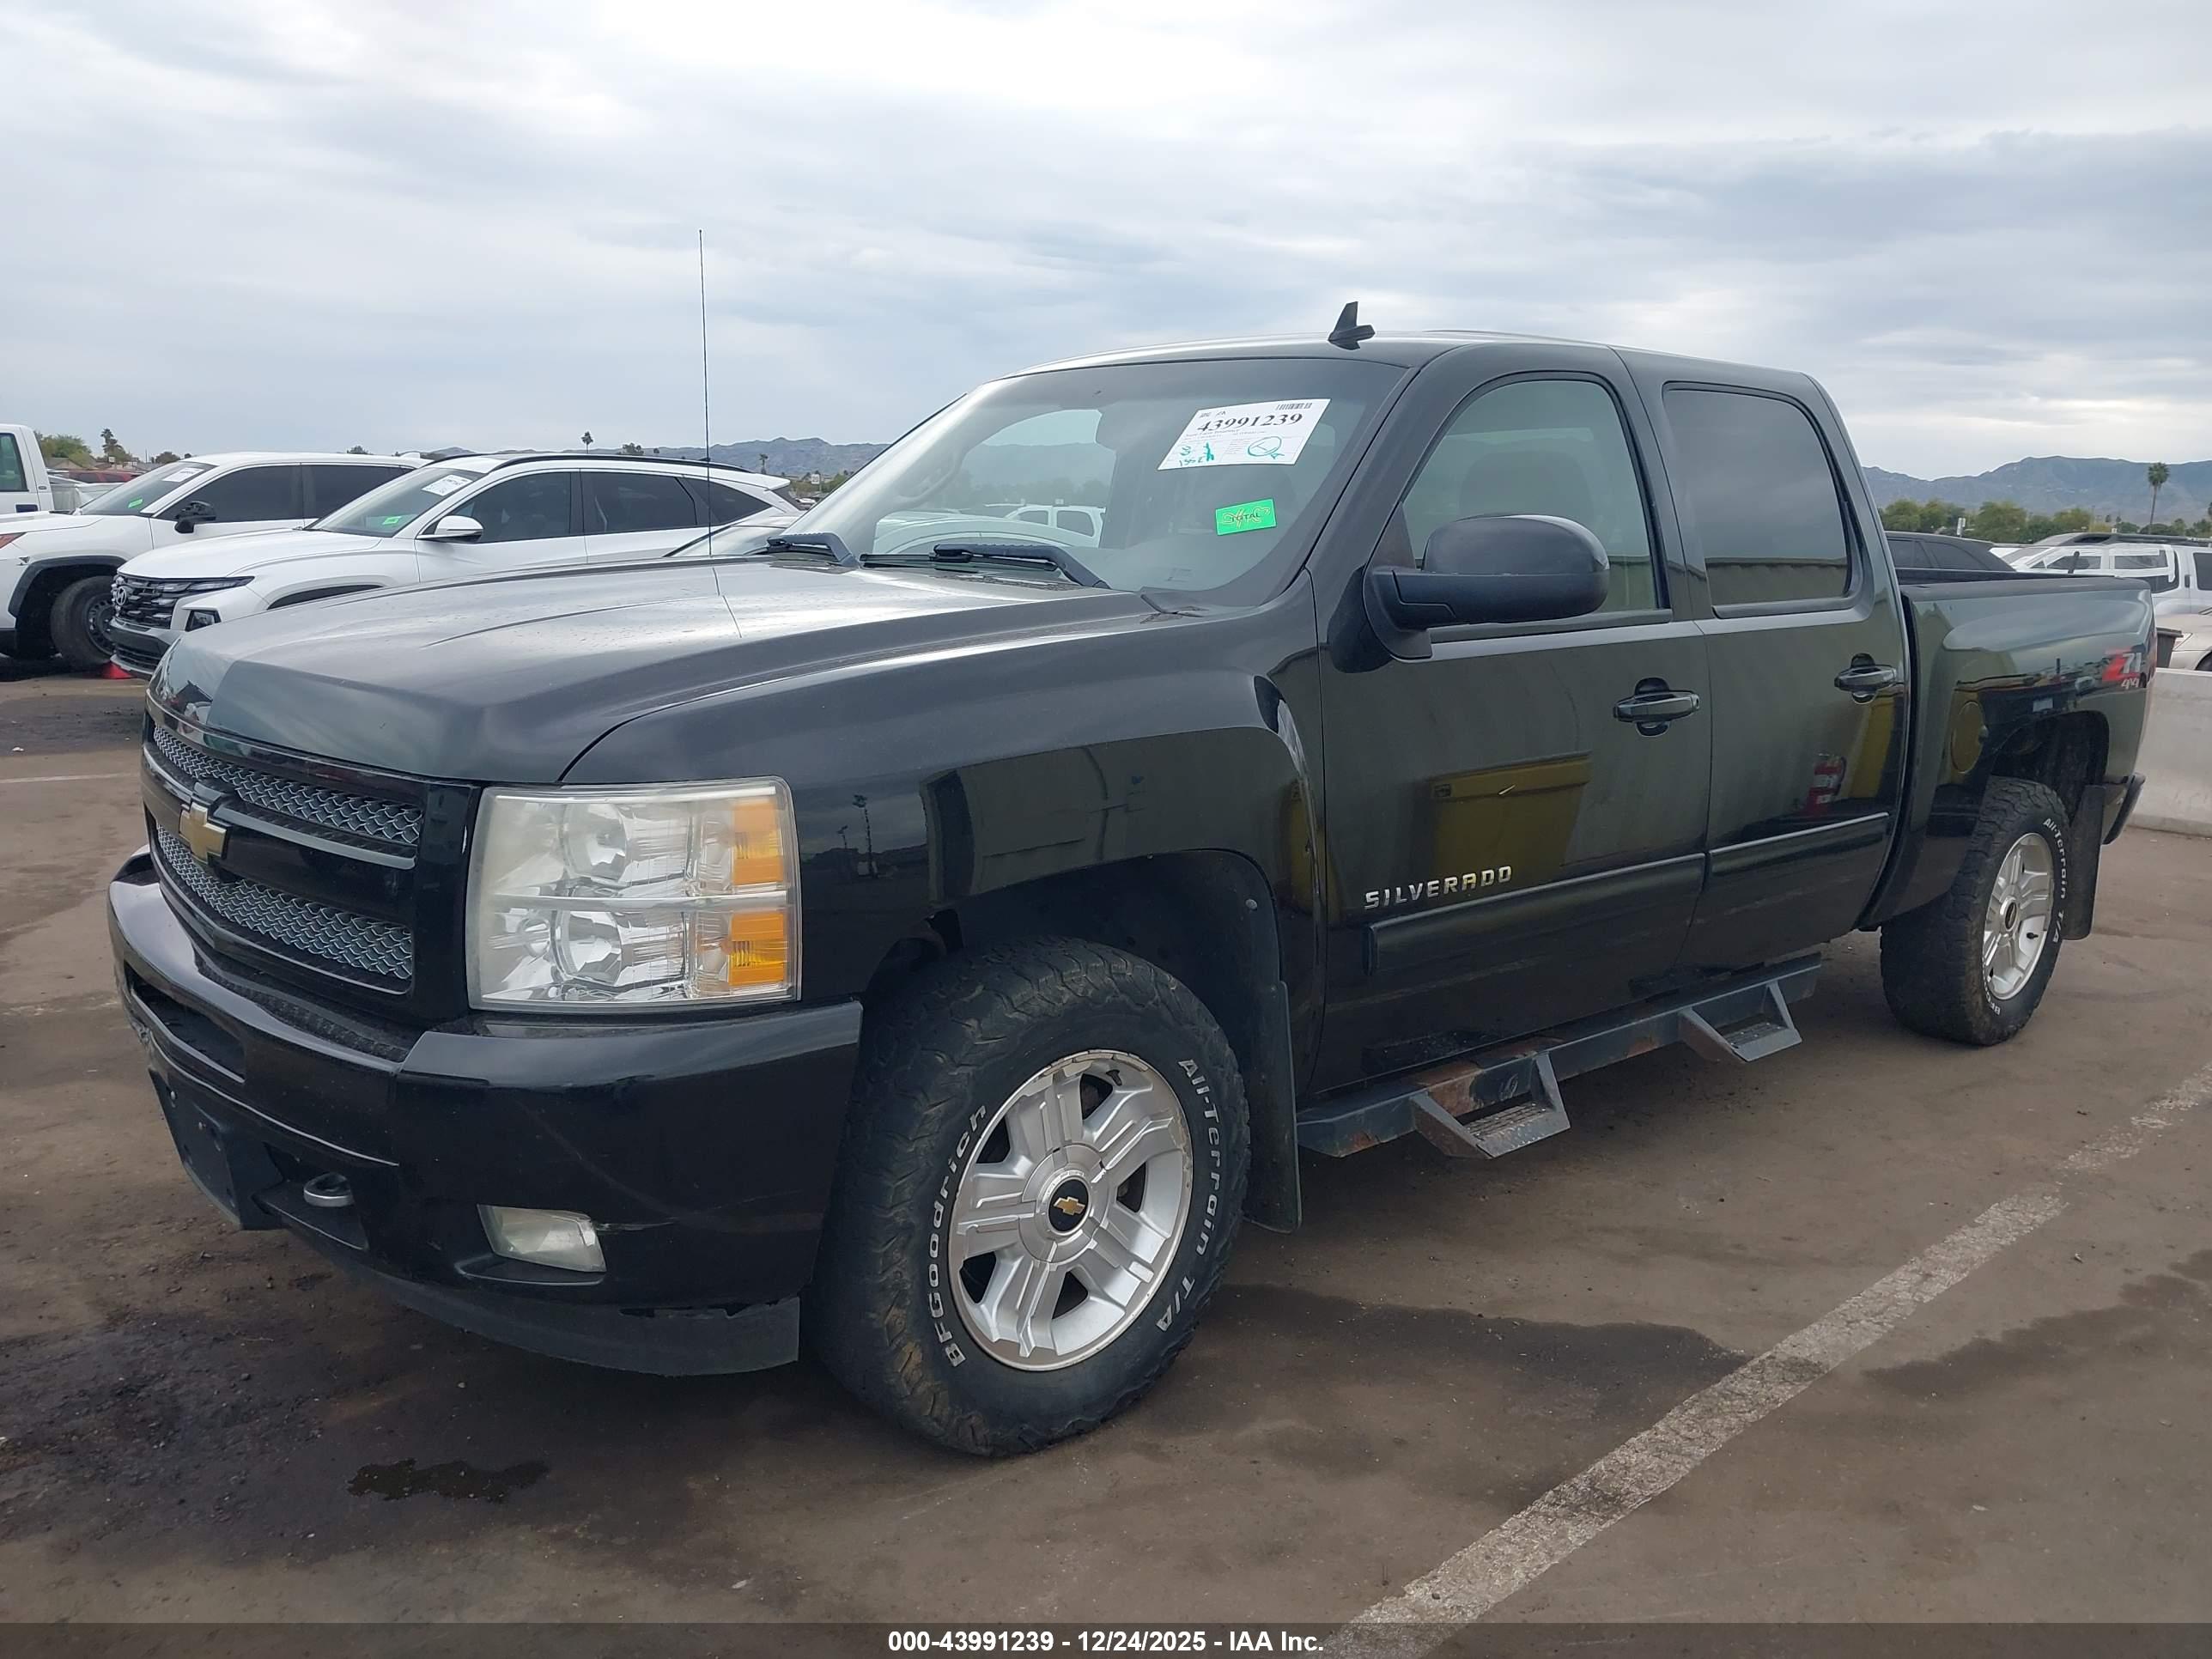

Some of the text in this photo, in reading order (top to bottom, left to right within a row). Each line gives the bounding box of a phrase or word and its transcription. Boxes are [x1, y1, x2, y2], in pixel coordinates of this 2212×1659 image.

[1197, 413, 1304, 432] 43991239
[2101, 647, 2142, 682] Z71
[1364, 866, 1512, 910] SILVERADO
[2043, 817, 2068, 899] All-Terrain
[1156, 1059, 1220, 1331] All-Terrain T/A
[929, 1105, 987, 1367] BFGoodrich
